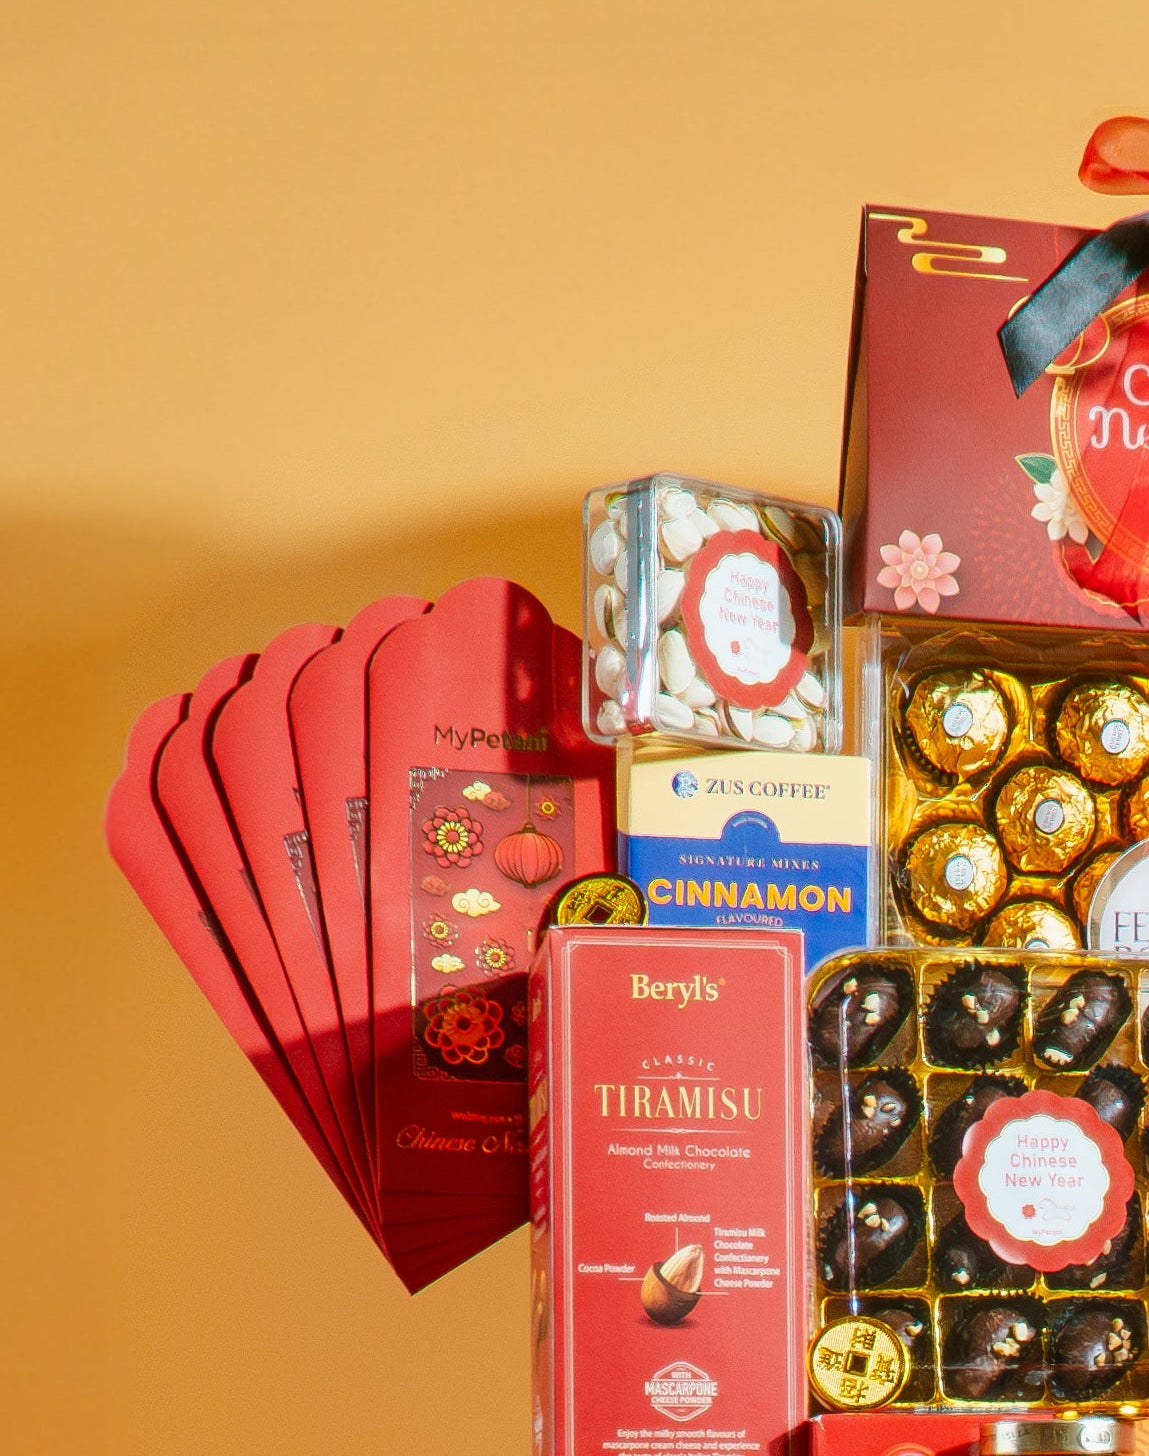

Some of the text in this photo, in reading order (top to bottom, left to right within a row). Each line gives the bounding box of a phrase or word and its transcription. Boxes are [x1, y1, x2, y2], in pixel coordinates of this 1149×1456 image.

[731, 569, 769, 592] Happy
[724, 588, 775, 611] Chinese
[718, 606, 780, 634] New Year
[434, 725, 549, 751] MyPetani
[706, 778, 826, 800] ZUS COFFEE
[678, 853, 821, 871] SIGNATURE MIXES
[647, 877, 852, 914] CINNAMON
[715, 913, 785, 928] FLAVOURED
[629, 973, 720, 1009] Beryl's
[641, 1054, 716, 1072] CLASSIC
[594, 1084, 763, 1121] TIRAMISU
[396, 1124, 477, 1152] Chinese
[1017, 1134, 1069, 1152] Happy
[607, 1143, 751, 1159] Almond Milk Chocolate
[643, 1159, 716, 1172] Confectionery
[1010, 1153, 1078, 1168] Chinese
[1004, 1173, 1085, 1188] New Year
[645, 1212, 711, 1224] Roasted Almond
[713, 1240, 754, 1250] Chocolate
[644, 1381, 719, 1397] MASCARPONE
